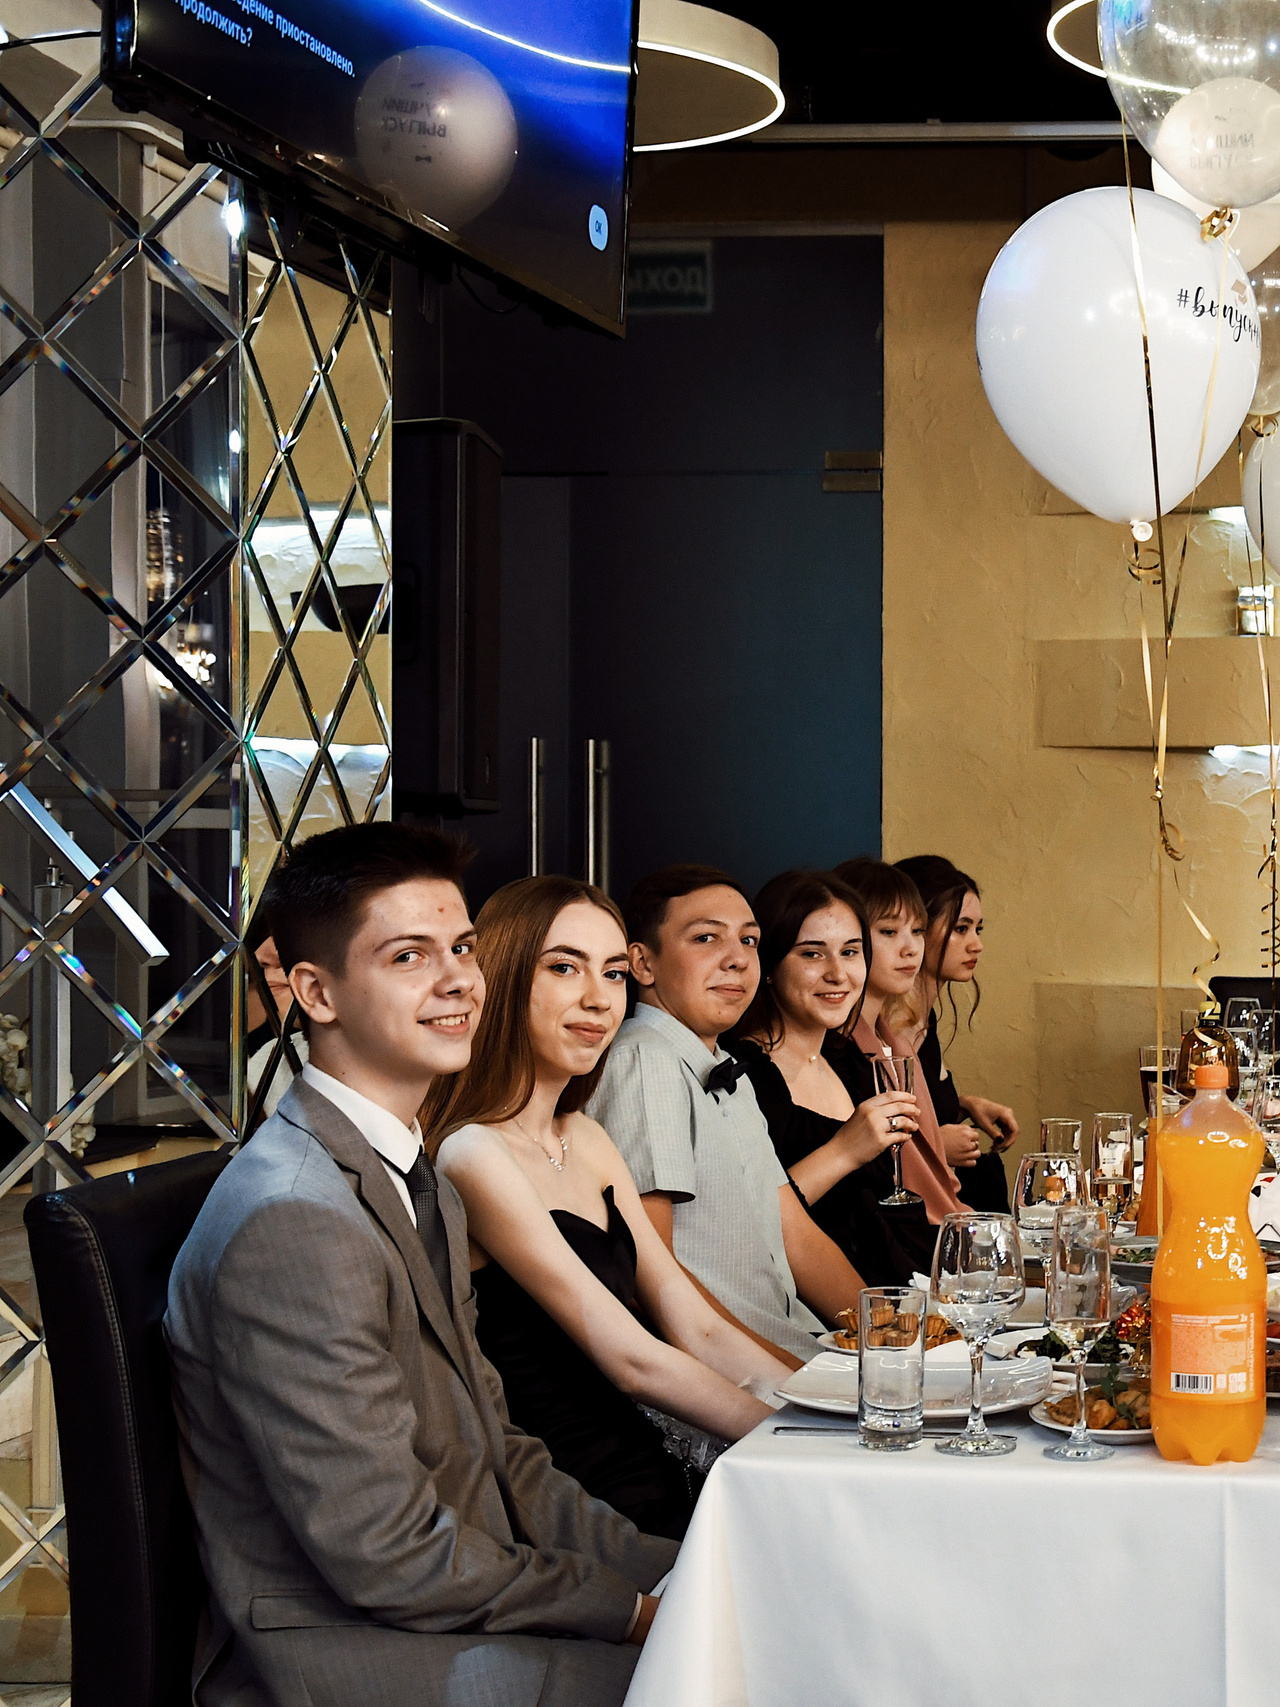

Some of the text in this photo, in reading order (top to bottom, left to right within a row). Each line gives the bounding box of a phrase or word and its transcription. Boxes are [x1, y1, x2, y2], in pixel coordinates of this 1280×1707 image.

[174, 0, 253, 47] родолжить?
[232, 0, 356, 78] едение приостановлено.
